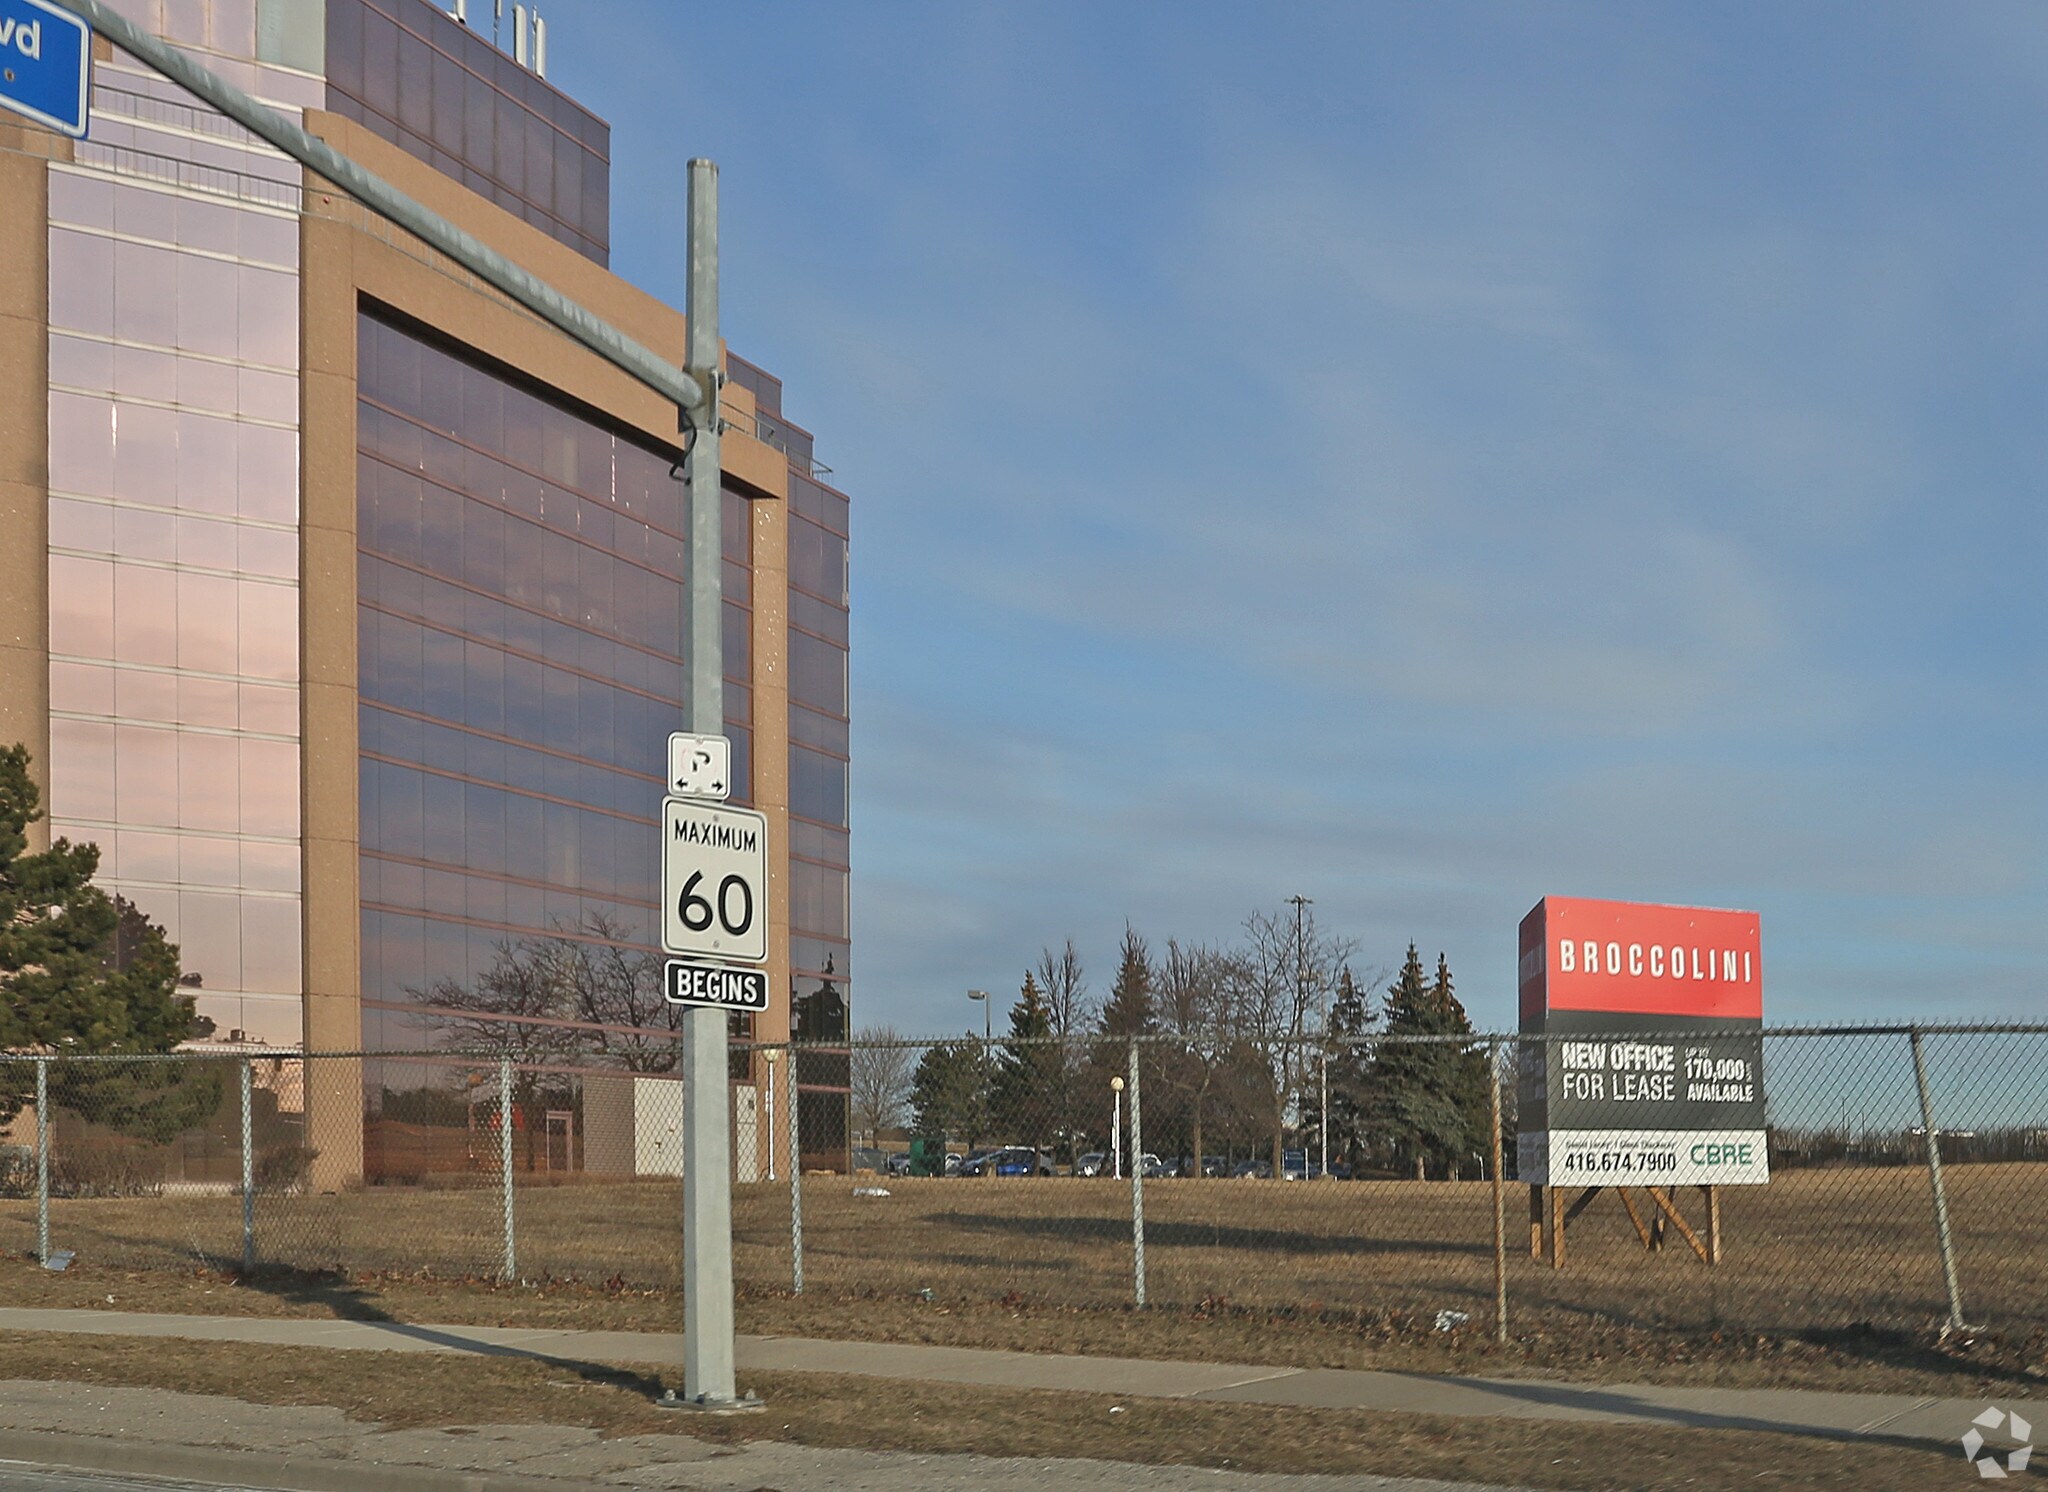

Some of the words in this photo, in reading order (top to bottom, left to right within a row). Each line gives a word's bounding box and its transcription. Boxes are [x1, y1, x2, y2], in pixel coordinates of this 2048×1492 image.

[674, 818, 756, 853] MAXIMUM
[678, 869, 753, 936] 60
[1559, 938, 1752, 984] BROCCOLINI
[676, 967, 758, 1003] BEGINS
[1561, 1041, 1607, 1070] NEW
[1610, 1042, 1676, 1072] OFFICE
[1684, 1058, 1745, 1083] 170,000
[1563, 1072, 1605, 1101] FOR
[1612, 1073, 1676, 1101] LEASE
[1687, 1082, 1754, 1102] AVAILABLE
[1565, 1151, 1677, 1172] 416.674.7900
[1690, 1144, 1752, 1166] CBRE
